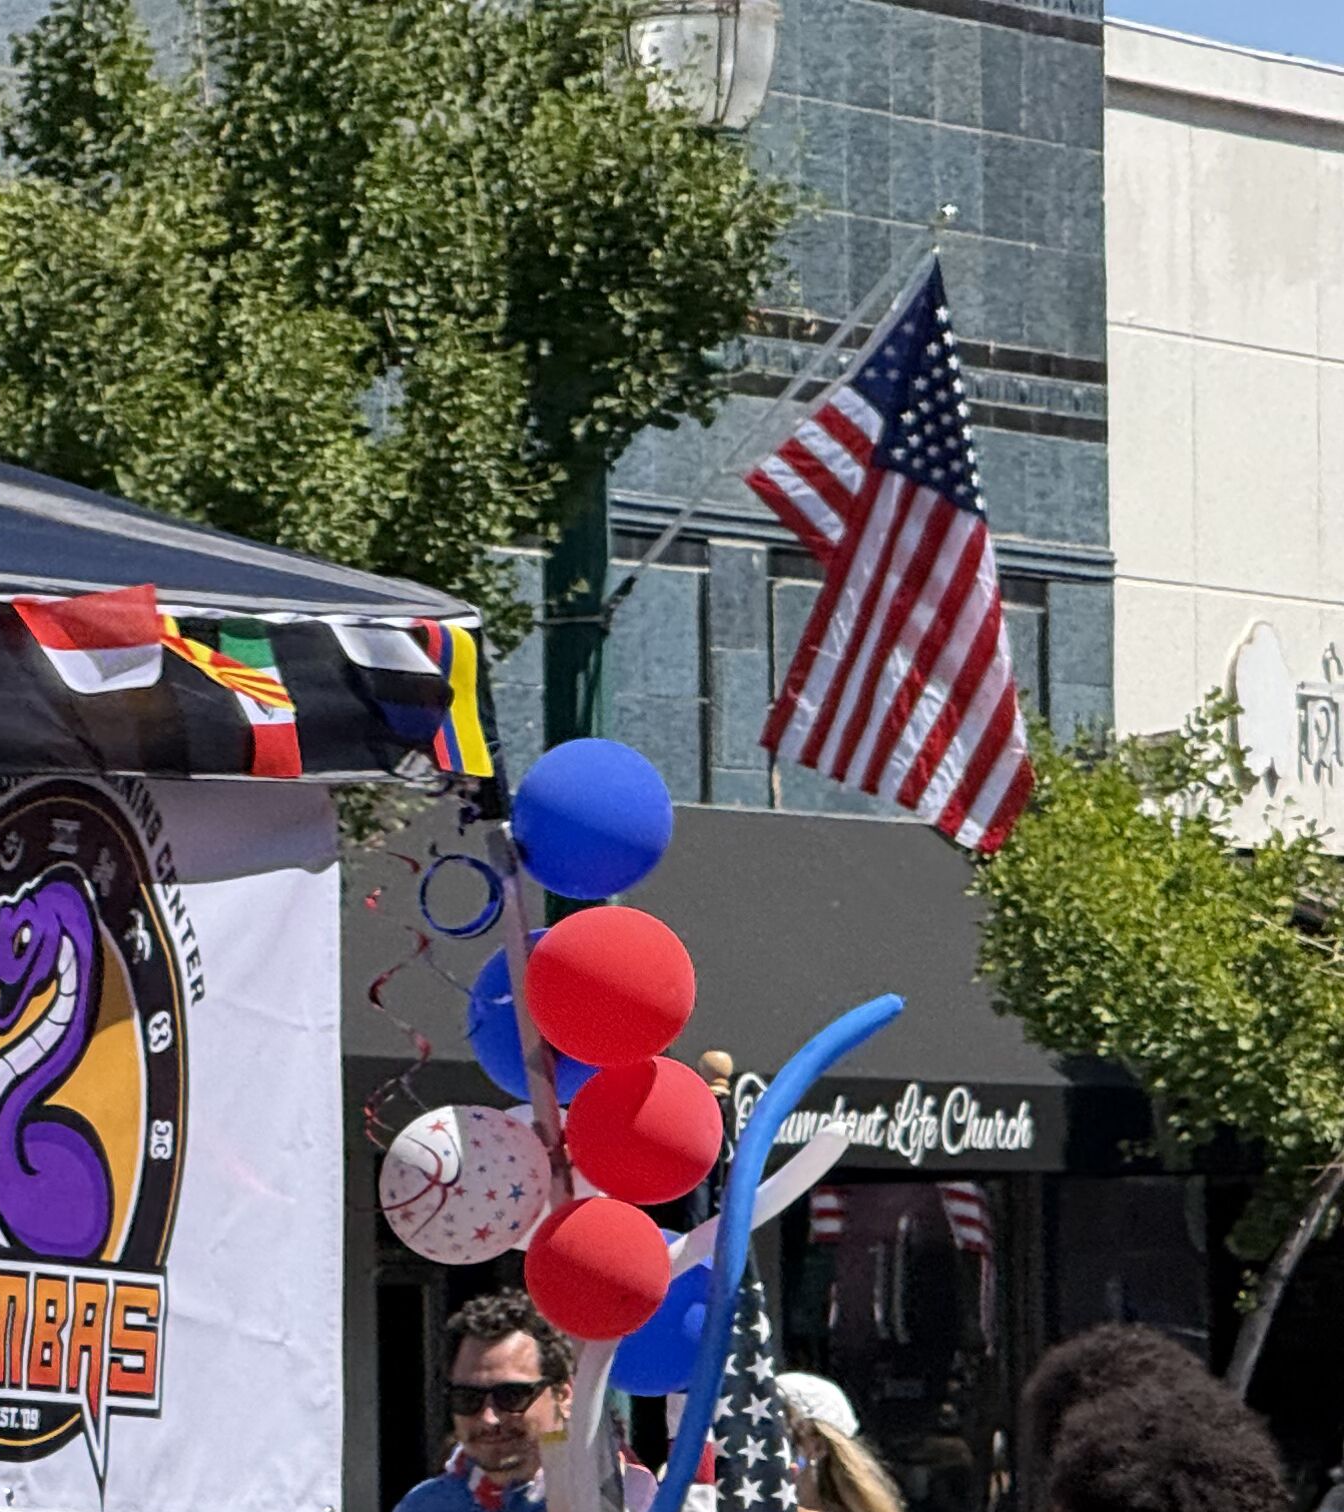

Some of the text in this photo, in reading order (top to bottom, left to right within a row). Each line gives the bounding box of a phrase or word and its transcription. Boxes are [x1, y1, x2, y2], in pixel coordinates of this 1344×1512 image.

[154, 840, 206, 1007] CENTER
[887, 1082, 939, 1166] Life
[941, 1086, 1033, 1155] Church
